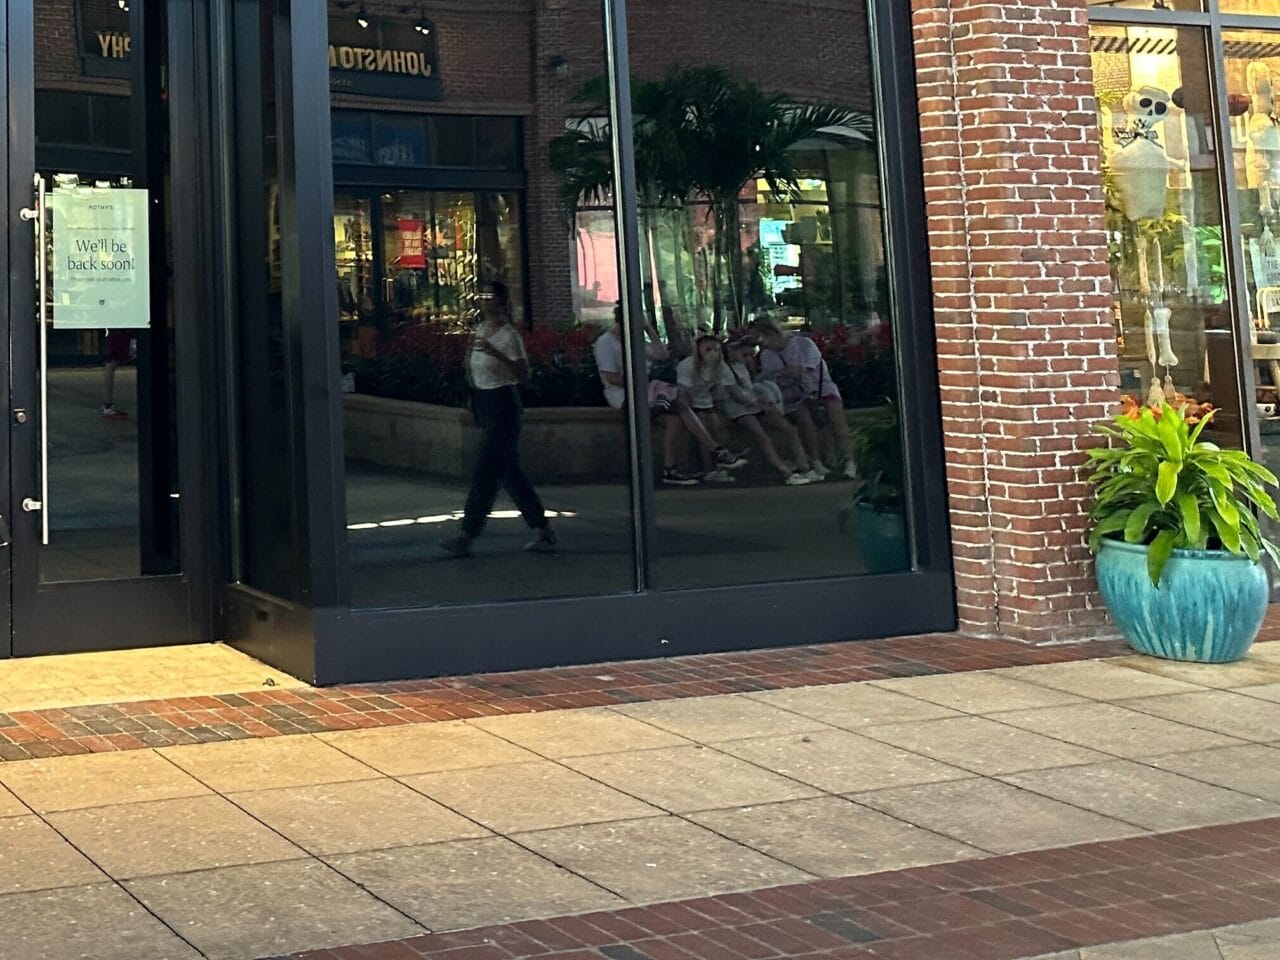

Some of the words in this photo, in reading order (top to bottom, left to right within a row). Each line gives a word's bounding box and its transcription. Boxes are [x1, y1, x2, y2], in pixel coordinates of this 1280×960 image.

[75, 239, 107, 253] We'll
[111, 238, 127, 253] be
[67, 256, 98, 270] back
[100, 257, 135, 270] soon!
